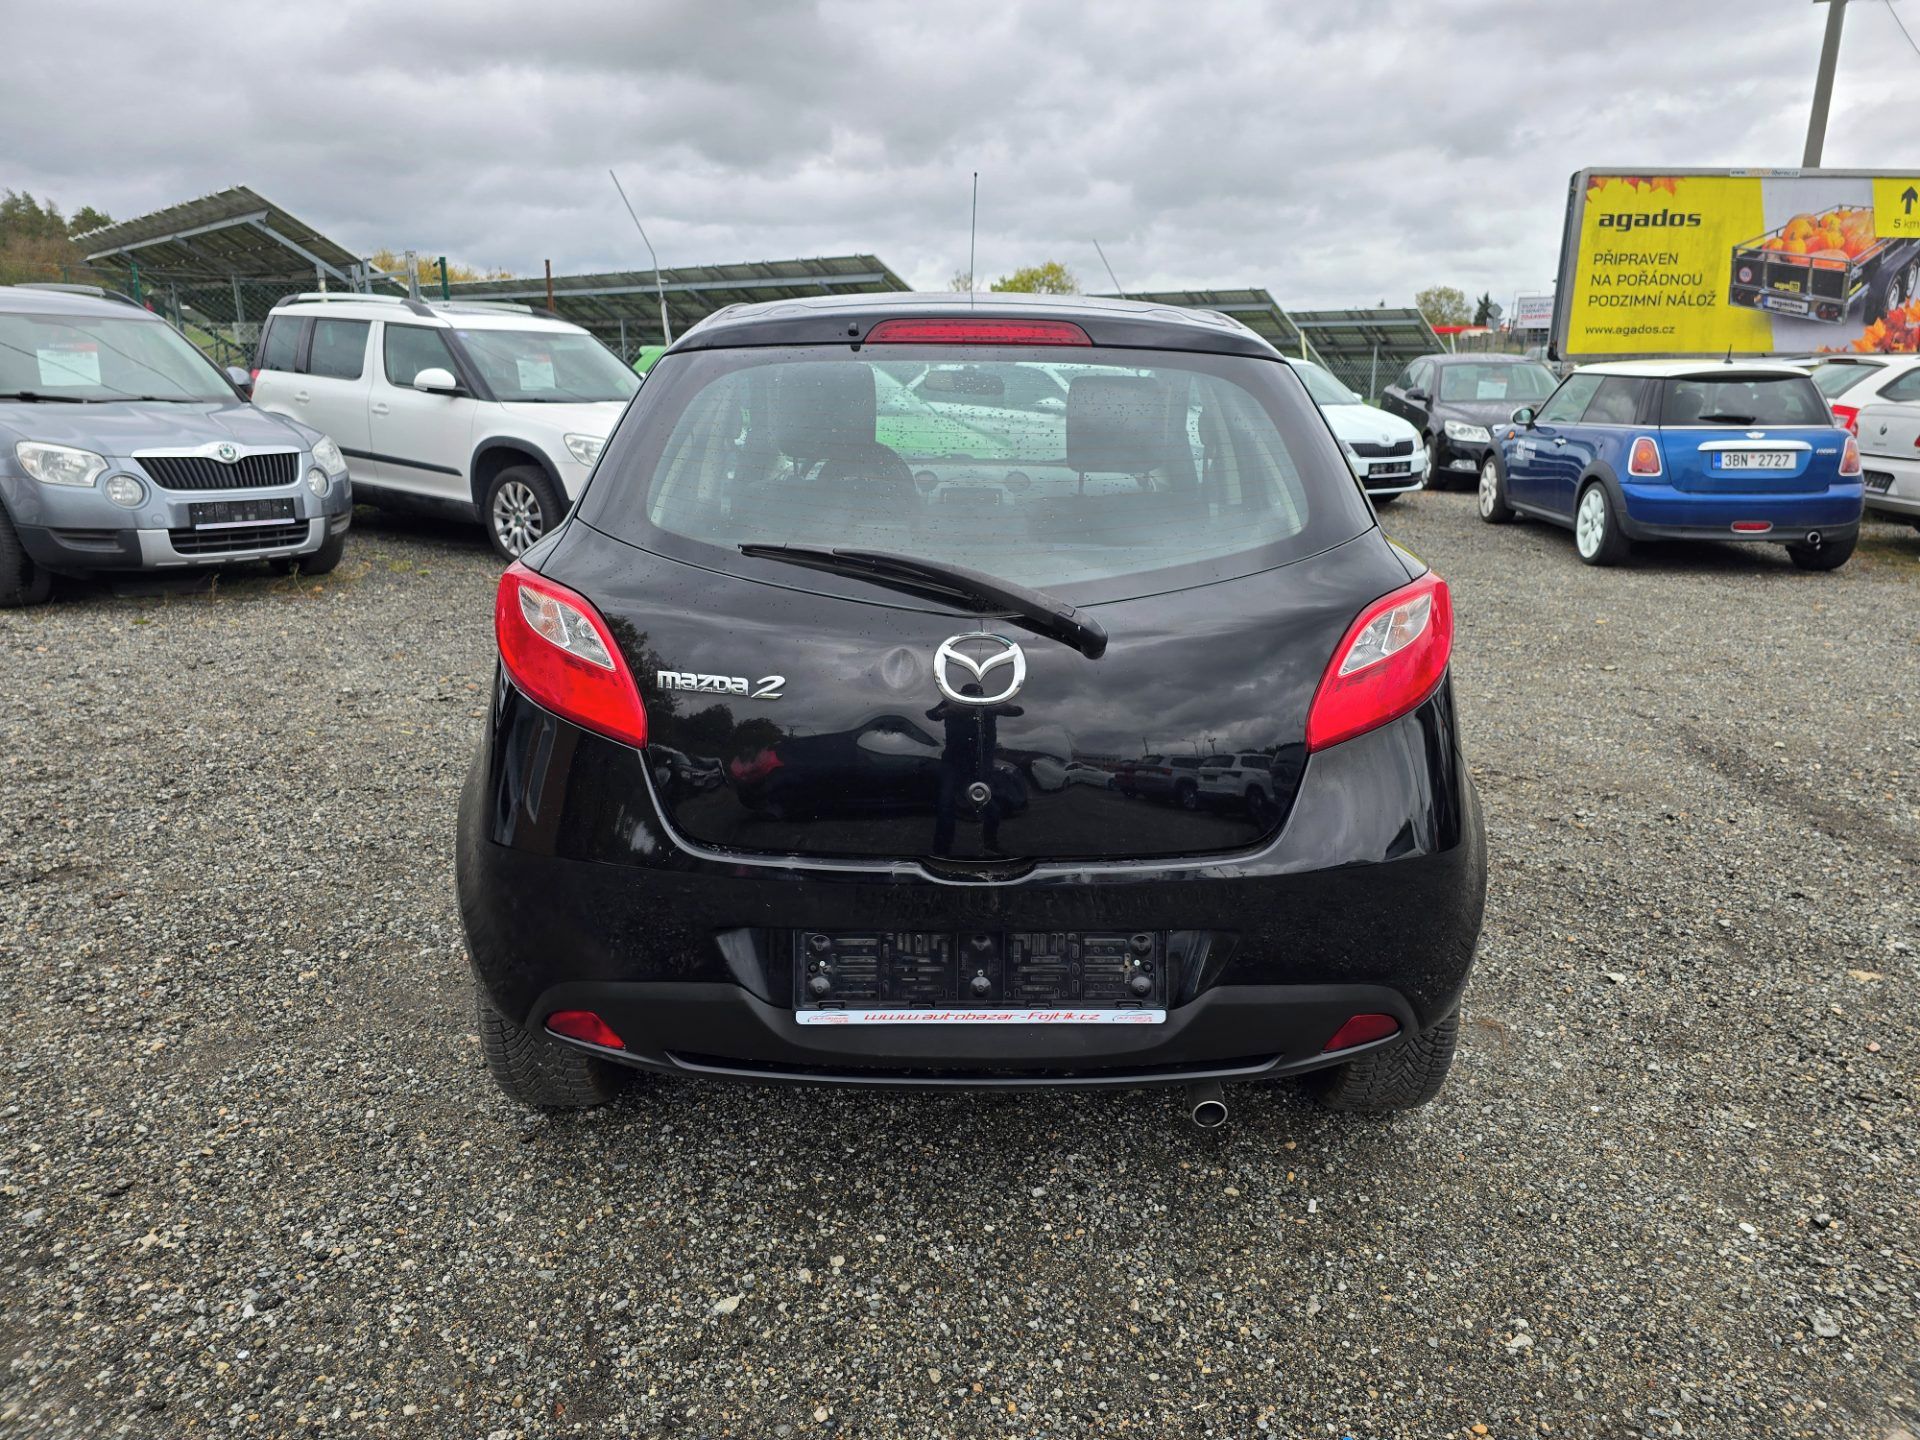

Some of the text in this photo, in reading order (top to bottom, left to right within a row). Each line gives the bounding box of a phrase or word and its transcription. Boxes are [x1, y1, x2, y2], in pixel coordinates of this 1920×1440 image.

[1599, 209, 1702, 232] agados
[1893, 218, 1920, 229] 5 km
[1593, 250, 1679, 265] PŘIPRAVEN
[1591, 270, 1703, 286] NA POŘÁDNOU
[1588, 291, 1717, 307] PODZIMNÍ NÁLOŽ
[1585, 325, 1676, 337] www.agados.cz
[1724, 454, 1790, 467] 3BN 2727
[751, 675, 786, 700] 2
